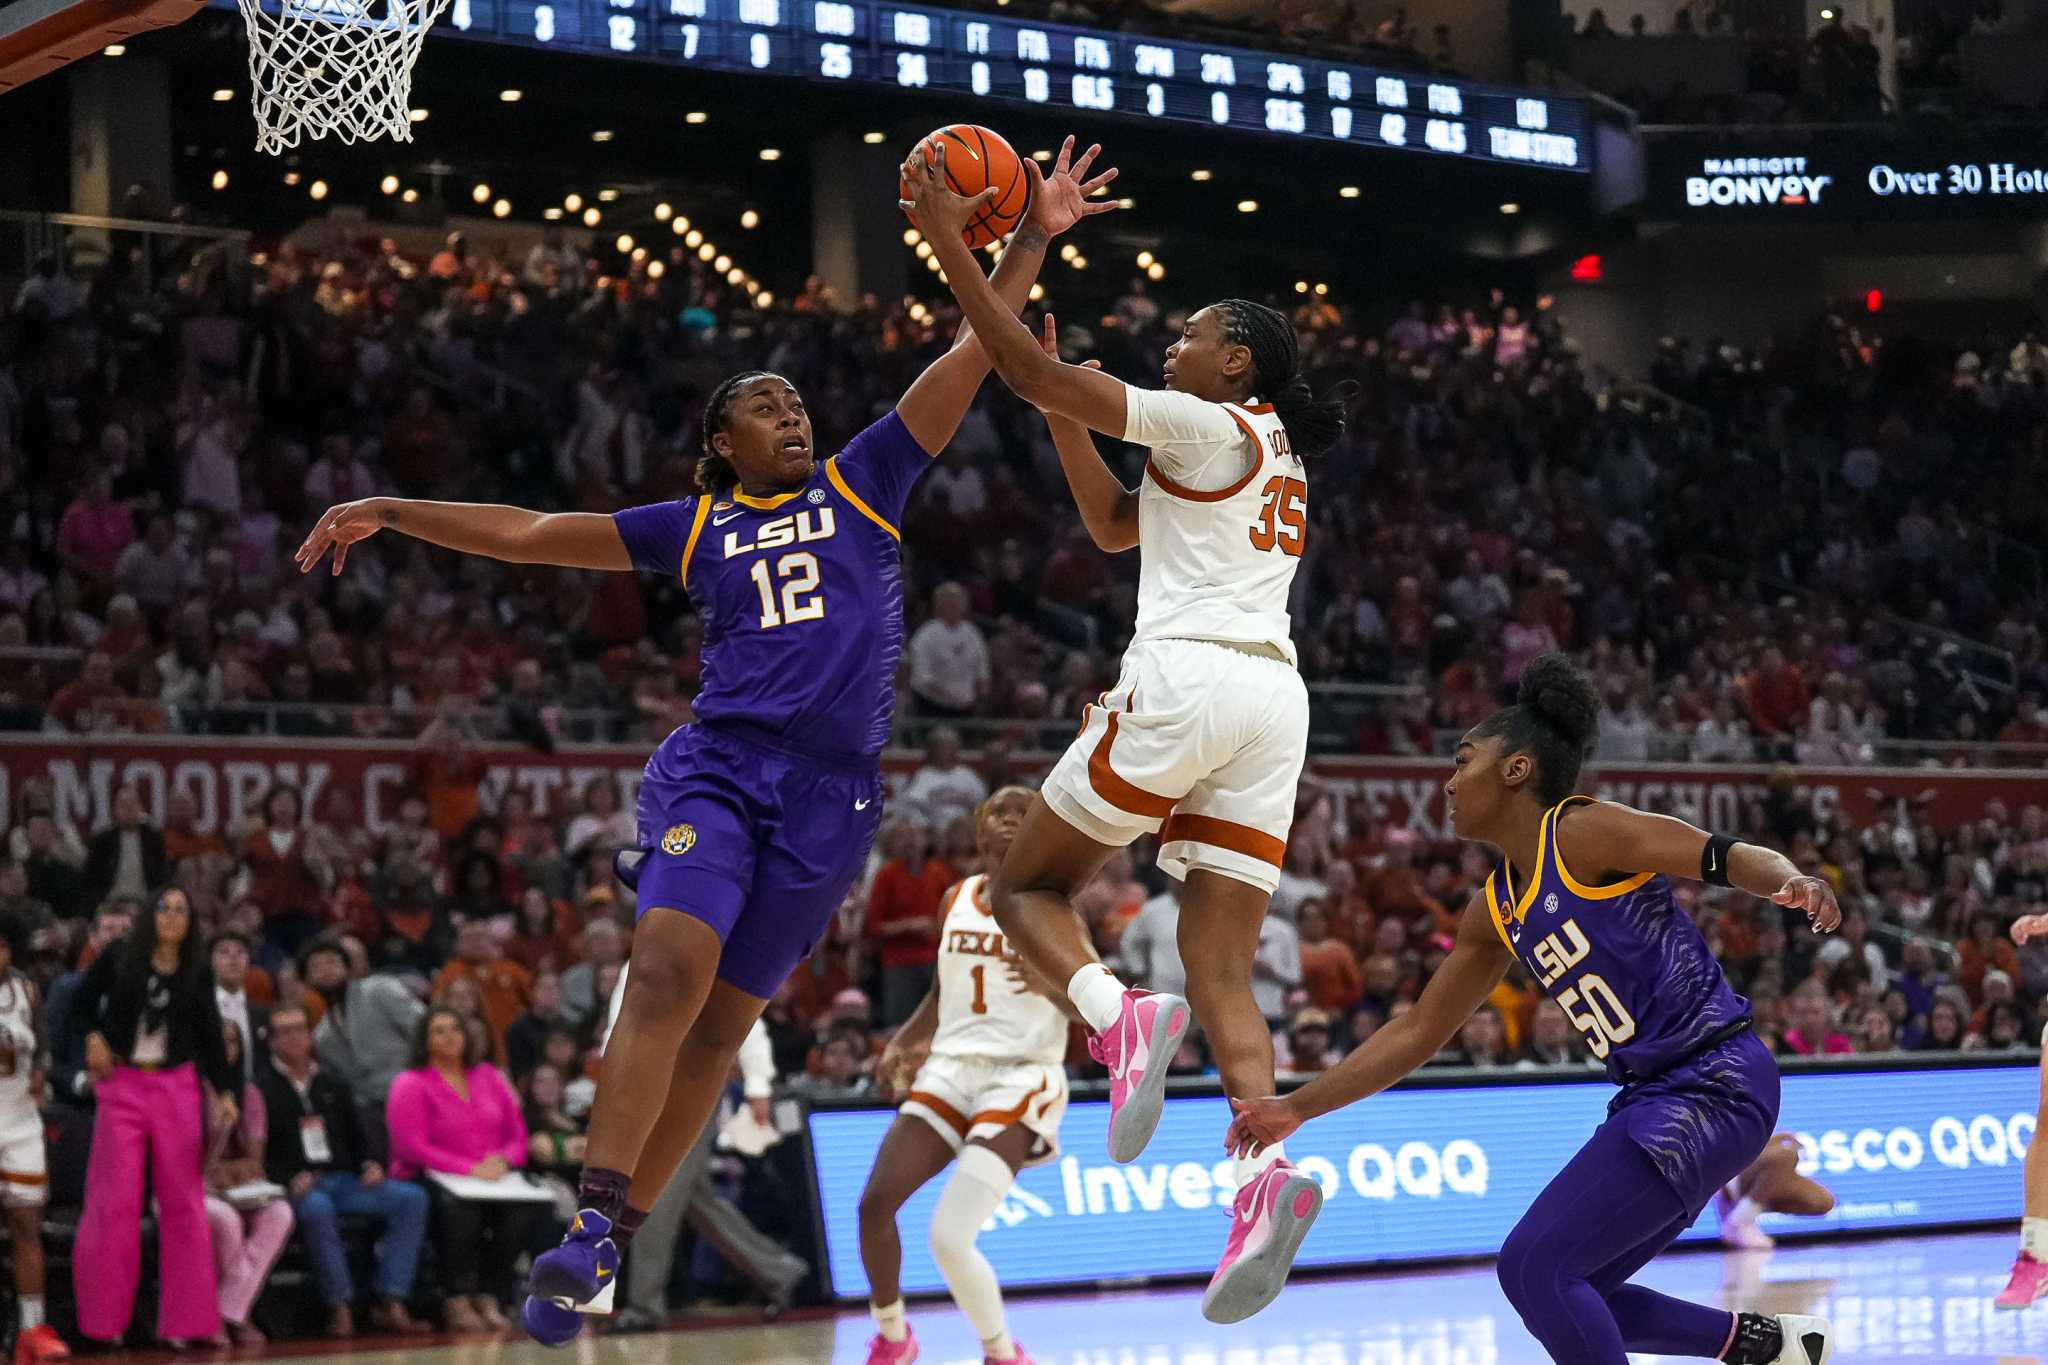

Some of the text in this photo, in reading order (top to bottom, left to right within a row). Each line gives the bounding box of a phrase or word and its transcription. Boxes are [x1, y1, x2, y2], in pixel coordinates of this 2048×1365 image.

[1686, 174, 1831, 206] BONVOY
[1704, 157, 1806, 174] MARRIOTT
[1869, 165, 1940, 195] Over
[1948, 164, 1982, 194] 30
[723, 507, 836, 560] LSU
[1249, 475, 1307, 557] 35
[750, 551, 825, 631] 12
[1526, 918, 1591, 989] LSU
[970, 963, 988, 1015] 1
[1556, 972, 1636, 1060] 50
[1061, 1139, 1489, 1215] Inveso QQQ
[1796, 1126, 1924, 1177] esco
